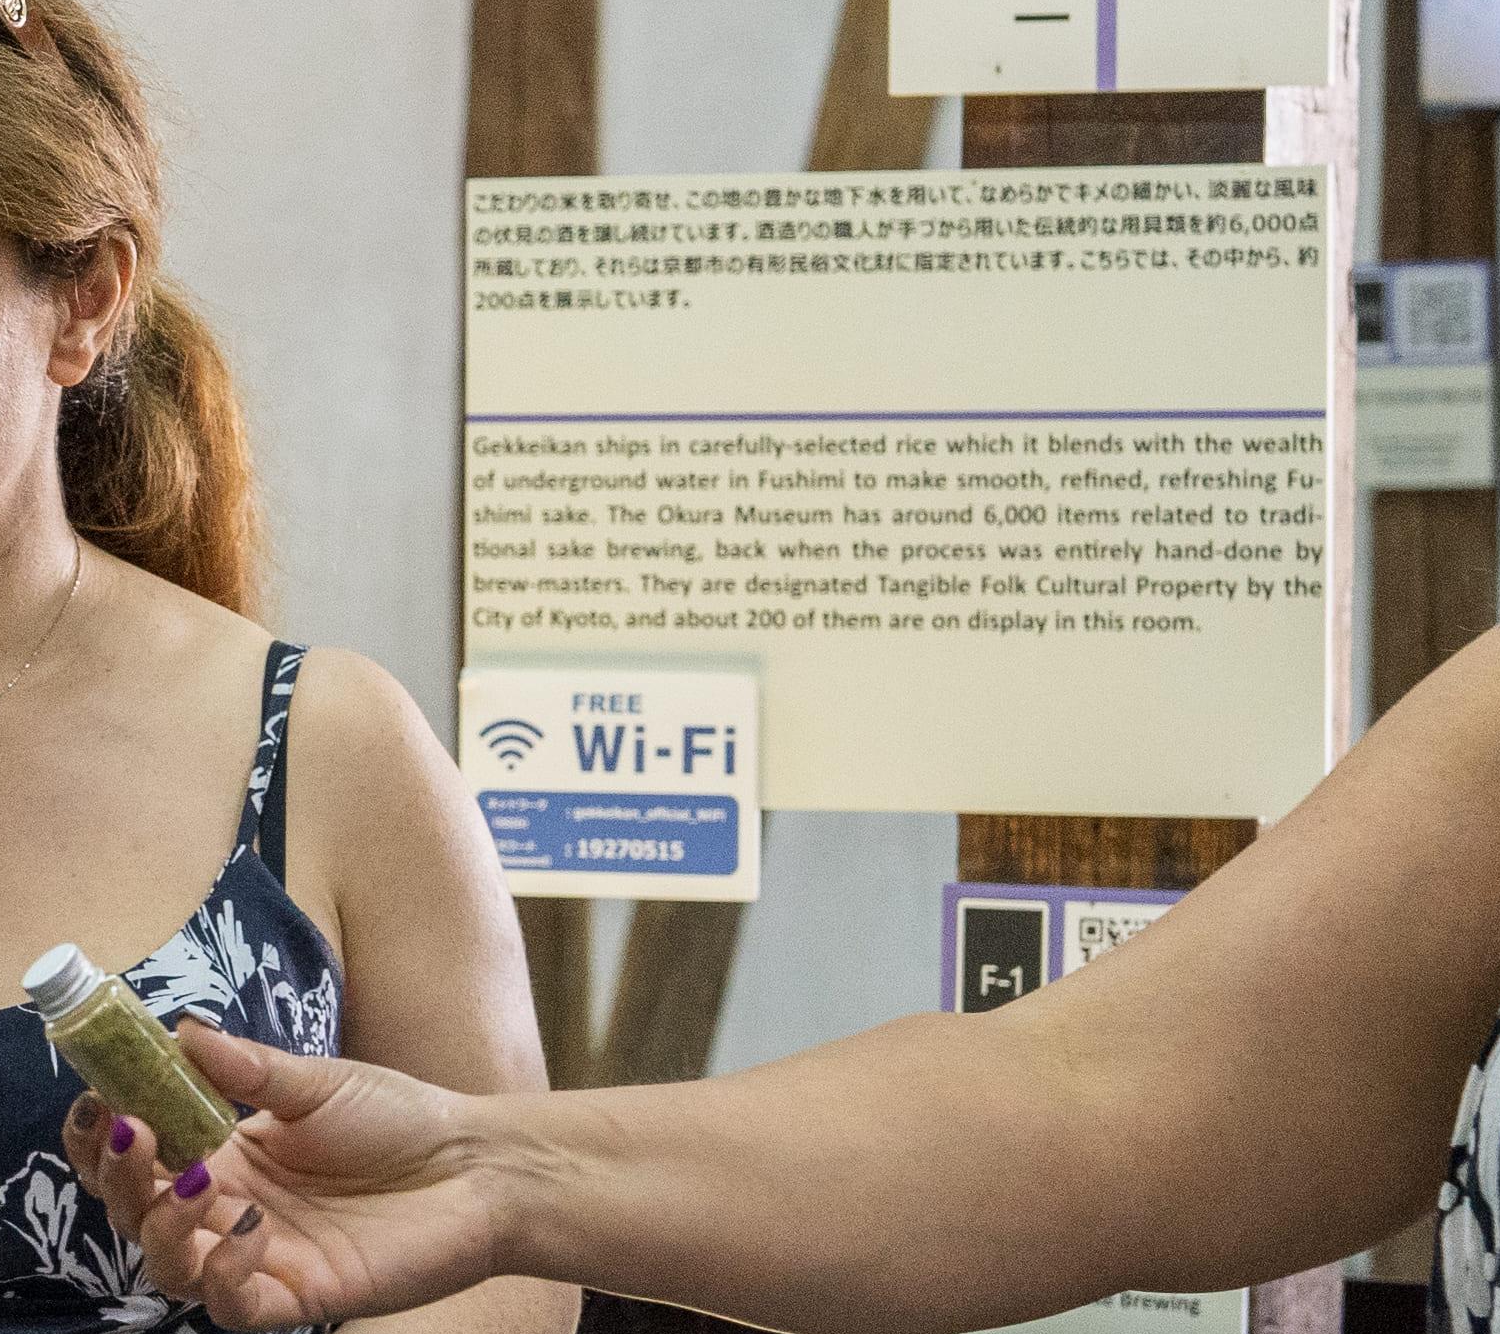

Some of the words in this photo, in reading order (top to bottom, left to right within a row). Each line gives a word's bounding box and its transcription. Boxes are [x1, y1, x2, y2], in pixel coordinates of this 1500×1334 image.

[472, 435, 586, 456] Gekkeikan
[596, 436, 651, 457] ships
[660, 435, 680, 455] in
[689, 434, 886, 458] carefully-selected
[896, 434, 937, 454] rice
[947, 433, 1013, 453] which
[1023, 434, 1039, 453] it
[1048, 432, 1124, 454] blends
[1133, 433, 1185, 453] with
[1195, 432, 1232, 453] the
[1243, 432, 1323, 453] wealth
[472, 471, 496, 490] of
[505, 471, 647, 495] underground
[656, 474, 719, 490] water
[729, 471, 748, 489] in
[758, 470, 844, 489] Fushimi
[855, 472, 877, 489] to
[886, 471, 947, 490] make
[957, 470, 1051, 492] smooth,
[1061, 469, 1149, 491] refined,
[1160, 469, 1277, 494] refreshing
[1287, 470, 1323, 489] Fu-
[473, 504, 532, 524] shimi
[543, 505, 596, 524] sake.
[608, 504, 646, 524] The
[658, 505, 723, 524] Okura
[735, 506, 833, 524] Museum
[844, 505, 881, 524] has
[893, 505, 973, 524] around
[984, 505, 1047, 527] 6,000
[1057, 505, 1120, 524] items
[1132, 505, 1213, 524] related
[1225, 507, 1248, 524] to
[1260, 505, 1323, 524] tradi-
[473, 539, 536, 559] tional
[547, 539, 594, 559] sake
[607, 539, 703, 564] brewing,
[716, 539, 765, 559] back
[778, 539, 840, 559] when
[853, 539, 889, 559] the
[902, 544, 986, 564] process
[999, 544, 1042, 560] was
[1055, 540, 1143, 564] entirely
[1155, 540, 1283, 561] hand-done
[1296, 540, 1322, 564] by
[473, 574, 630, 594] brew-masters.
[641, 574, 692, 597] They
[702, 579, 736, 594] are
[745, 574, 868, 599] designated
[878, 575, 970, 598] Tangible
[980, 575, 1026, 596] Folk
[1036, 575, 1126, 596] Cultural
[1136, 577, 1237, 601] Property
[1248, 577, 1274, 601] by
[1285, 577, 1322, 597] the
[472, 607, 513, 629] City
[521, 607, 544, 627] of
[549, 610, 619, 632] Kyoto,
[626, 609, 666, 628] and
[674, 609, 738, 628] about
[746, 610, 786, 628] 200
[793, 609, 815, 628] of
[824, 609, 881, 628] them
[888, 612, 924, 629] are
[932, 614, 959, 629] on
[968, 610, 1047, 634] display
[1056, 610, 1076, 629] in
[1084, 610, 1124, 630] this
[1133, 614, 1201, 632] room.
[572, 693, 643, 714] FREE
[572, 723, 736, 775] Wi-Fi
[577, 837, 686, 861] 19270515
[979, 965, 1023, 998] F-1
